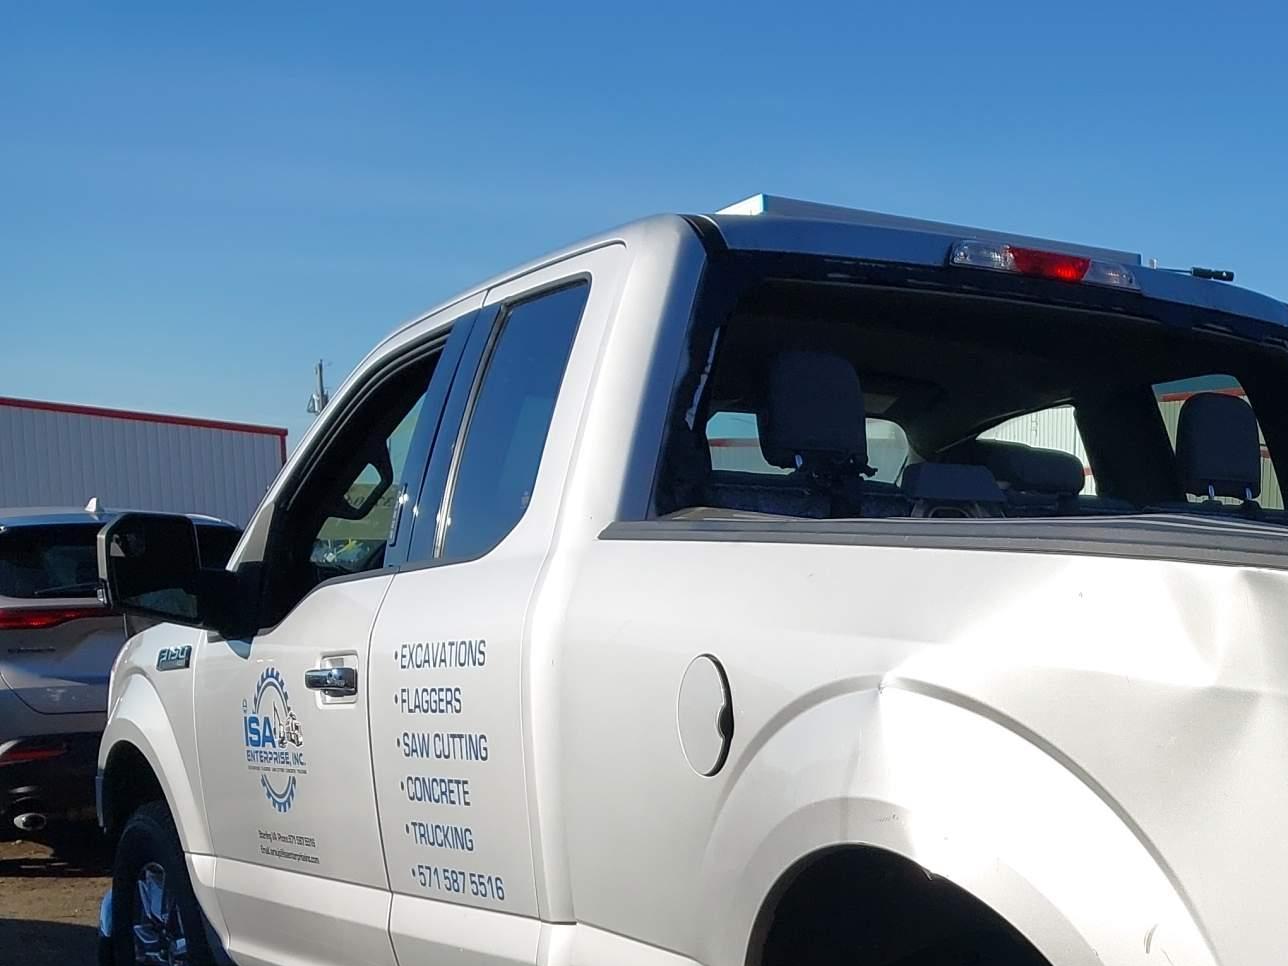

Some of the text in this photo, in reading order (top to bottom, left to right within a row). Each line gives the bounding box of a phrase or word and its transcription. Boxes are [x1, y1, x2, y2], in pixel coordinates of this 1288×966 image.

[400, 640, 487, 669] EXCAVATIONS
[400, 687, 462, 714] FLAGGERS
[243, 716, 276, 748] ISA
[403, 732, 489, 762] SAW CUTTING
[406, 776, 471, 806] CONCRETE
[411, 821, 474, 852] TRUCKING
[418, 864, 505, 901] 571 587 5516
